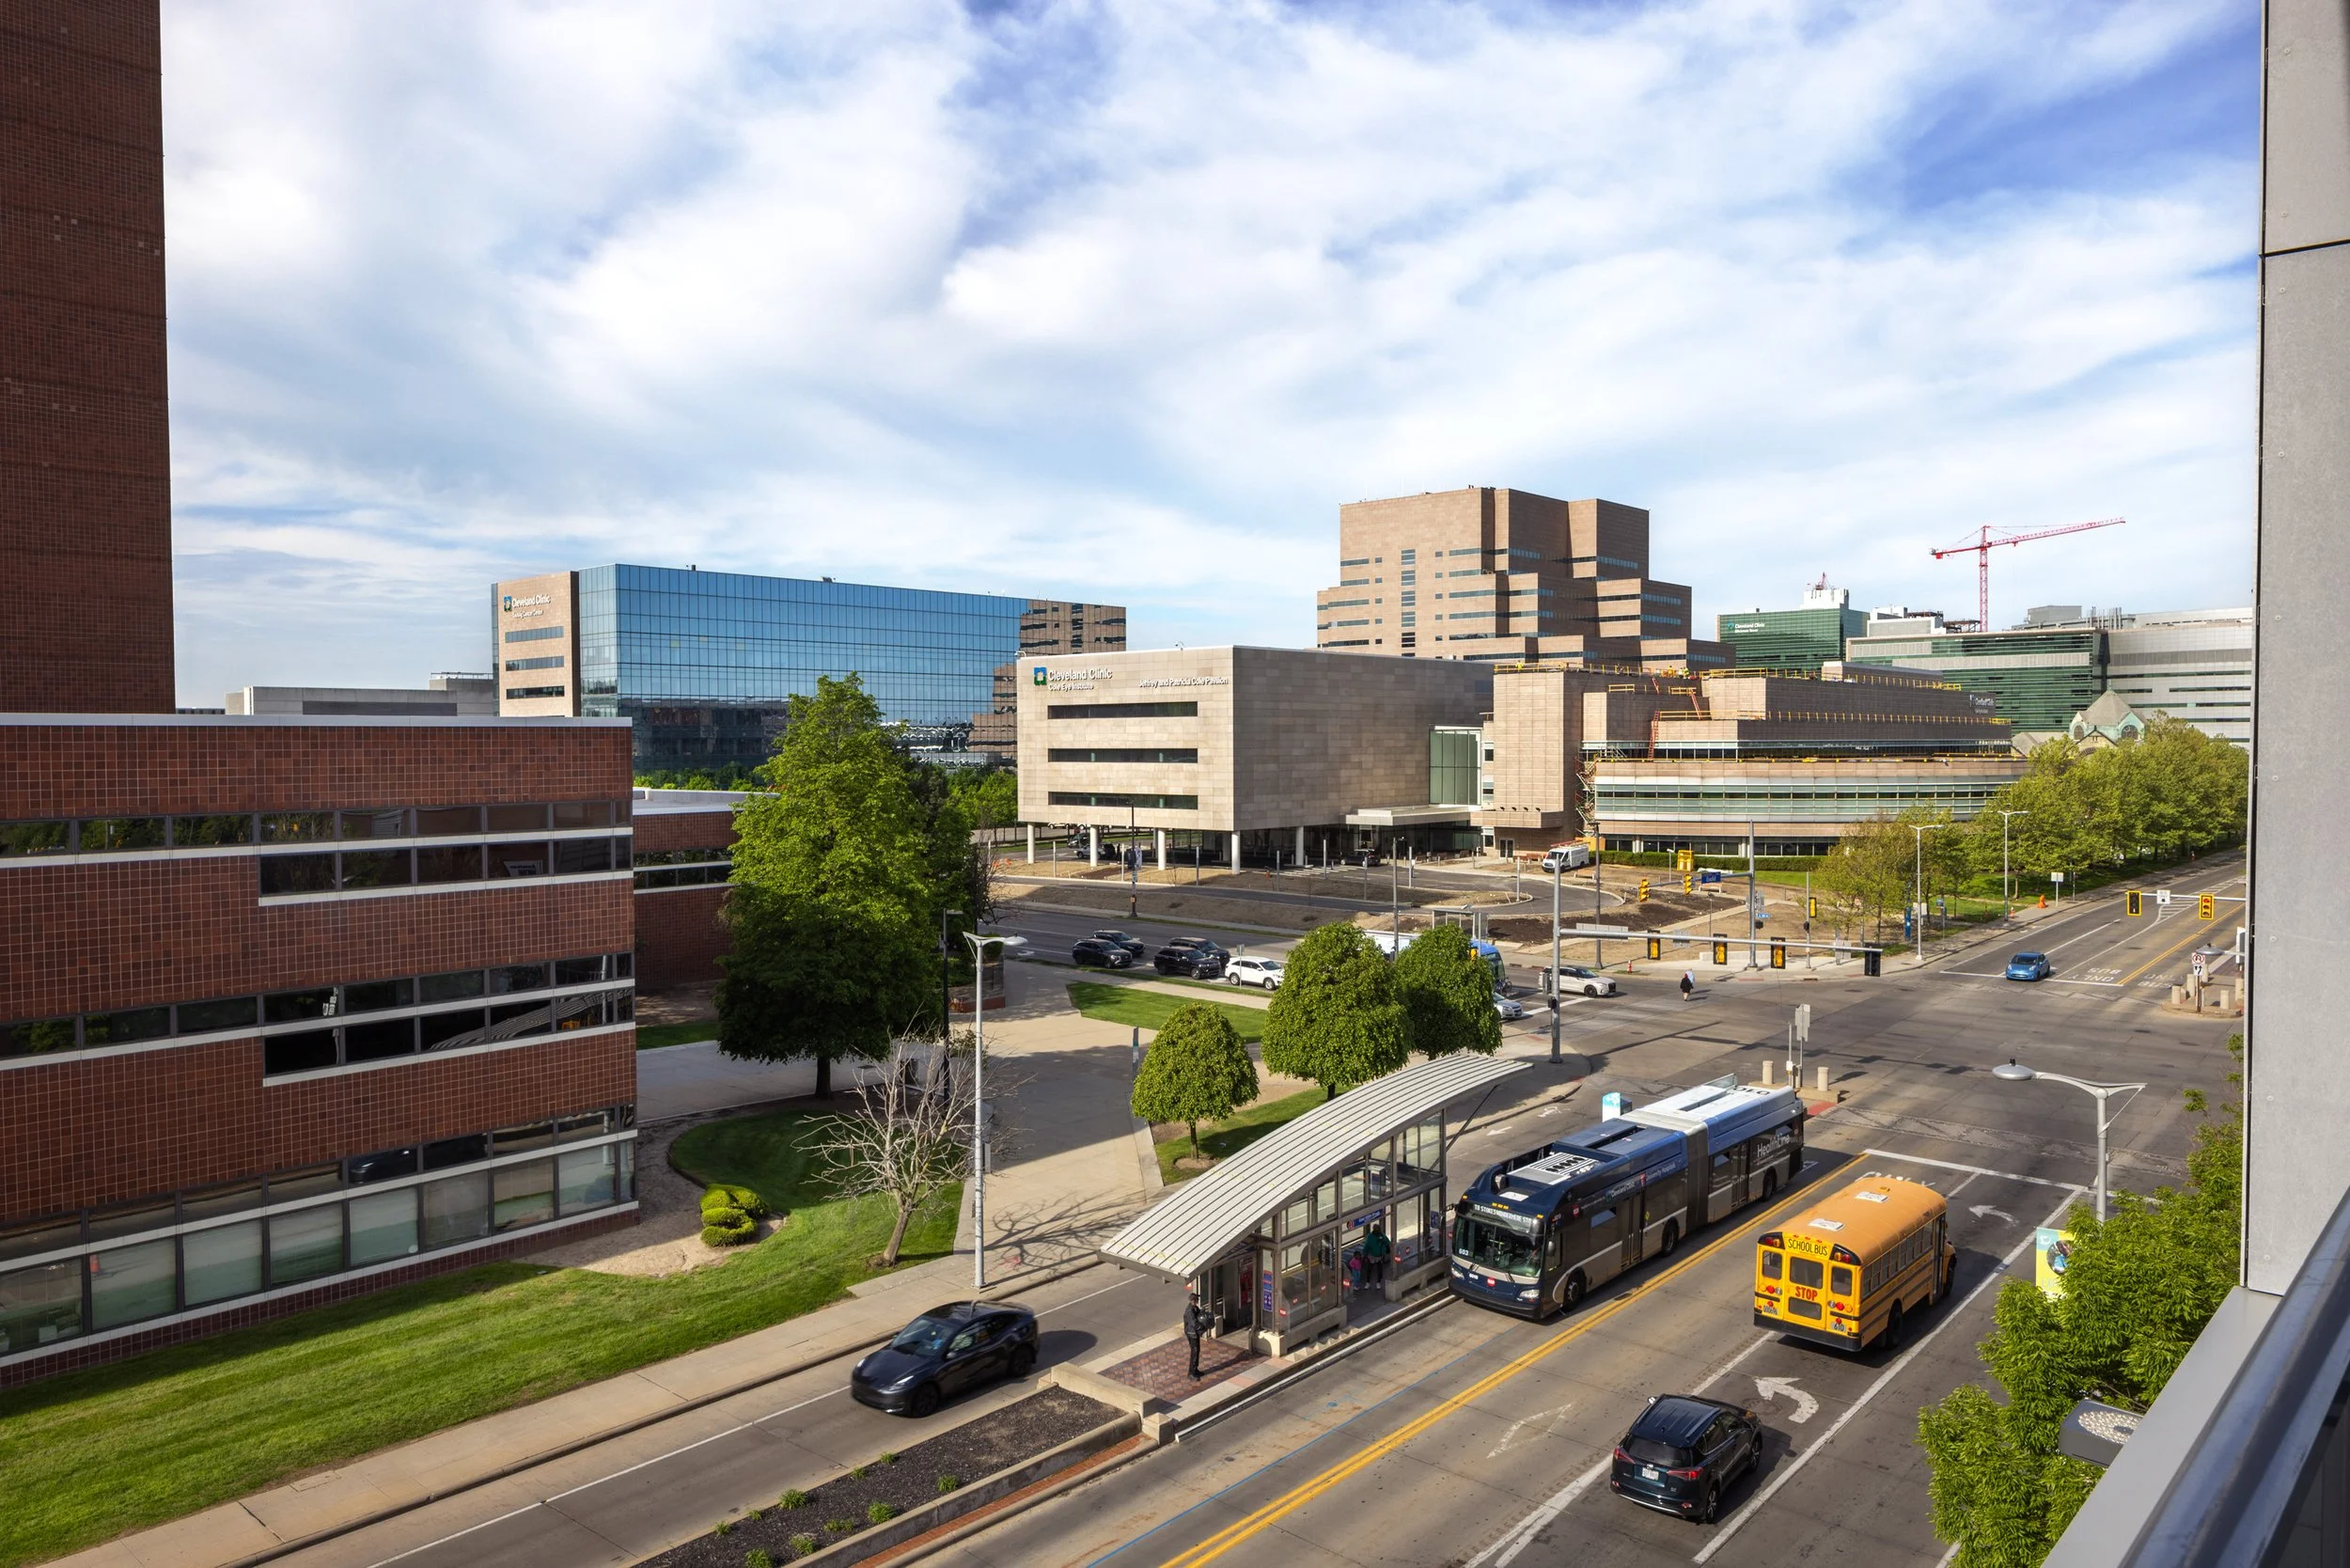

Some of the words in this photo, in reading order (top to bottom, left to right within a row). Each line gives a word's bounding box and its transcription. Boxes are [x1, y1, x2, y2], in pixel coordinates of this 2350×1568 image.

[1048, 668, 1088, 682] Cleveland
[1089, 667, 1113, 680] Clinic
[1061, 682, 1073, 692] Eye
[2068, 973, 2114, 982] ONLY
[1757, 1135, 1791, 1158] HealthLine
[1788, 1238, 1813, 1254] SCHOOL
[1814, 1243, 1828, 1257] BUS
[1794, 1286, 1818, 1301] STOP
[1834, 1323, 1844, 1331] 610
